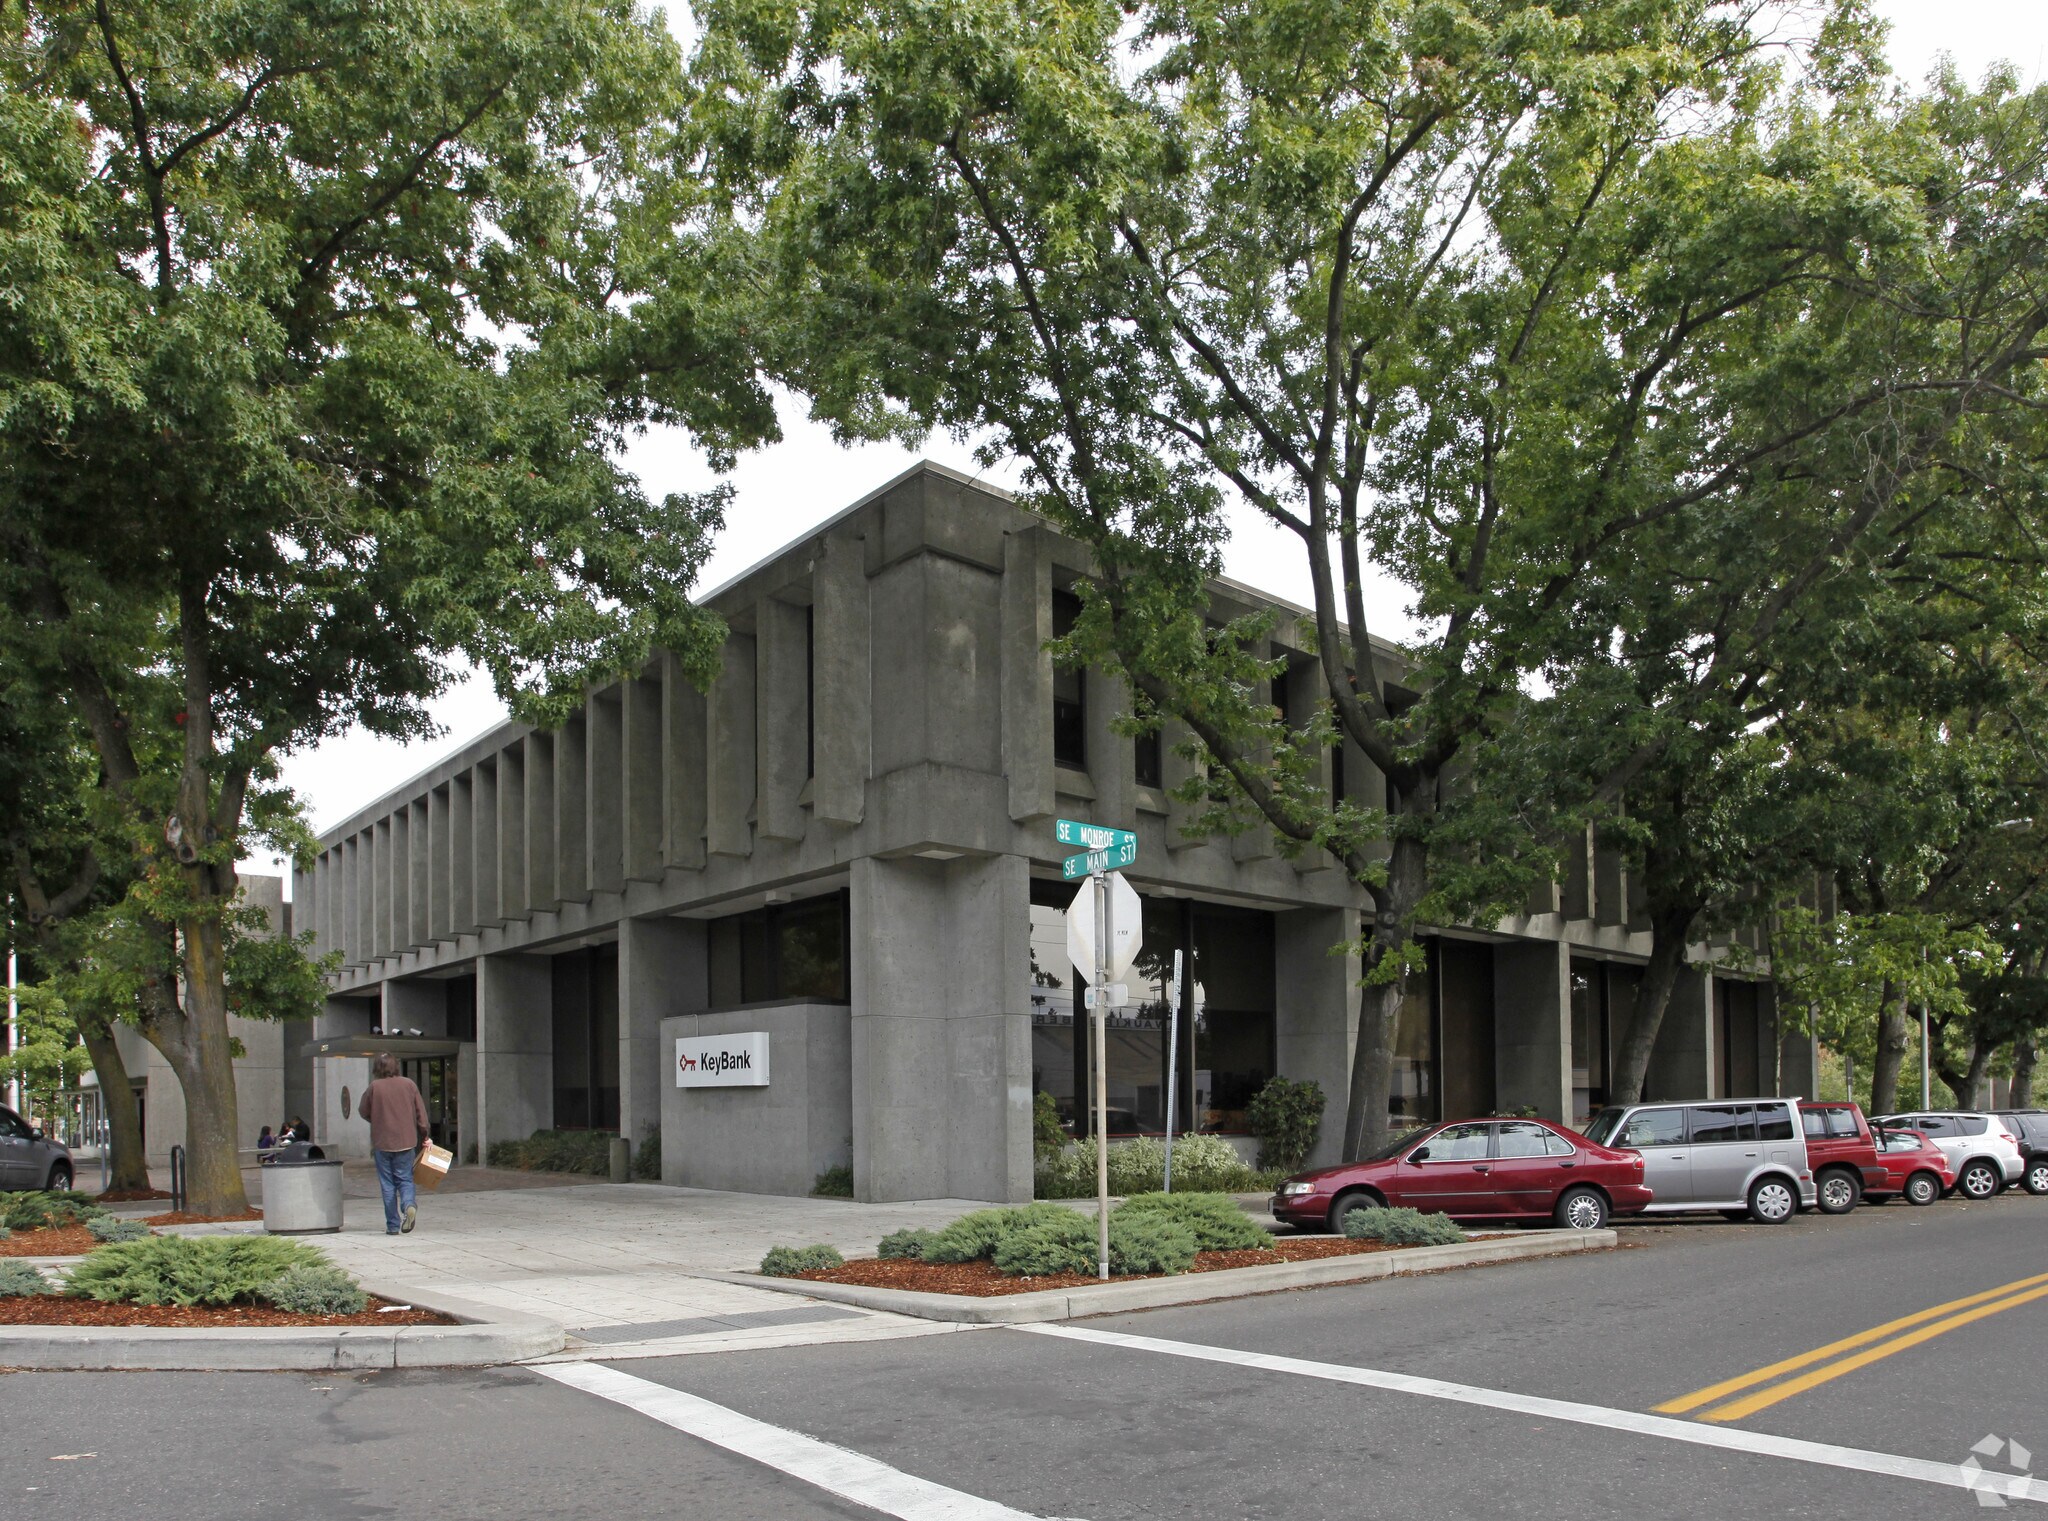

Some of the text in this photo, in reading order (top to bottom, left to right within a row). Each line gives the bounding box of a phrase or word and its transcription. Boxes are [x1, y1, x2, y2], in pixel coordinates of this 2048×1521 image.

[1059, 823, 1070, 840] SE
[1081, 827, 1114, 847] MONROE
[1065, 845, 1132, 876] SE MAIN ST
[701, 1050, 751, 1076] KeyBank
